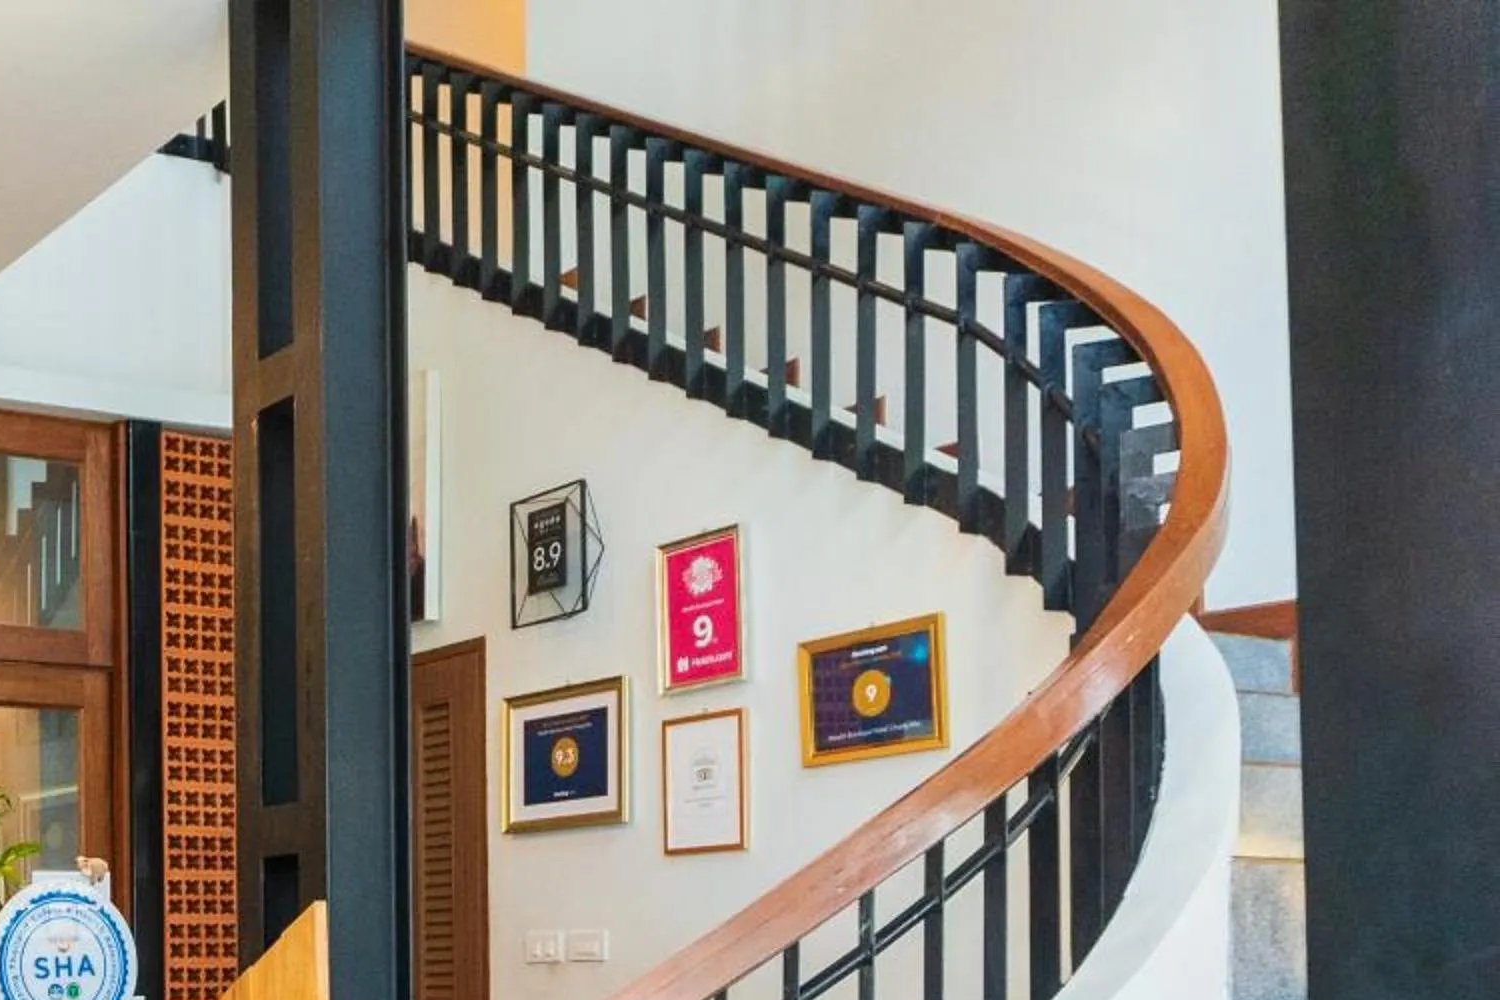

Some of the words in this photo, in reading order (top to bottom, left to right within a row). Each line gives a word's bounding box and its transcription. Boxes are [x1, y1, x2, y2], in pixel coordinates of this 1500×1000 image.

[533, 541, 561, 571] 8.9
[693, 615, 713, 648] 9
[865, 684, 877, 702] 9
[34, 954, 96, 979] SHA
